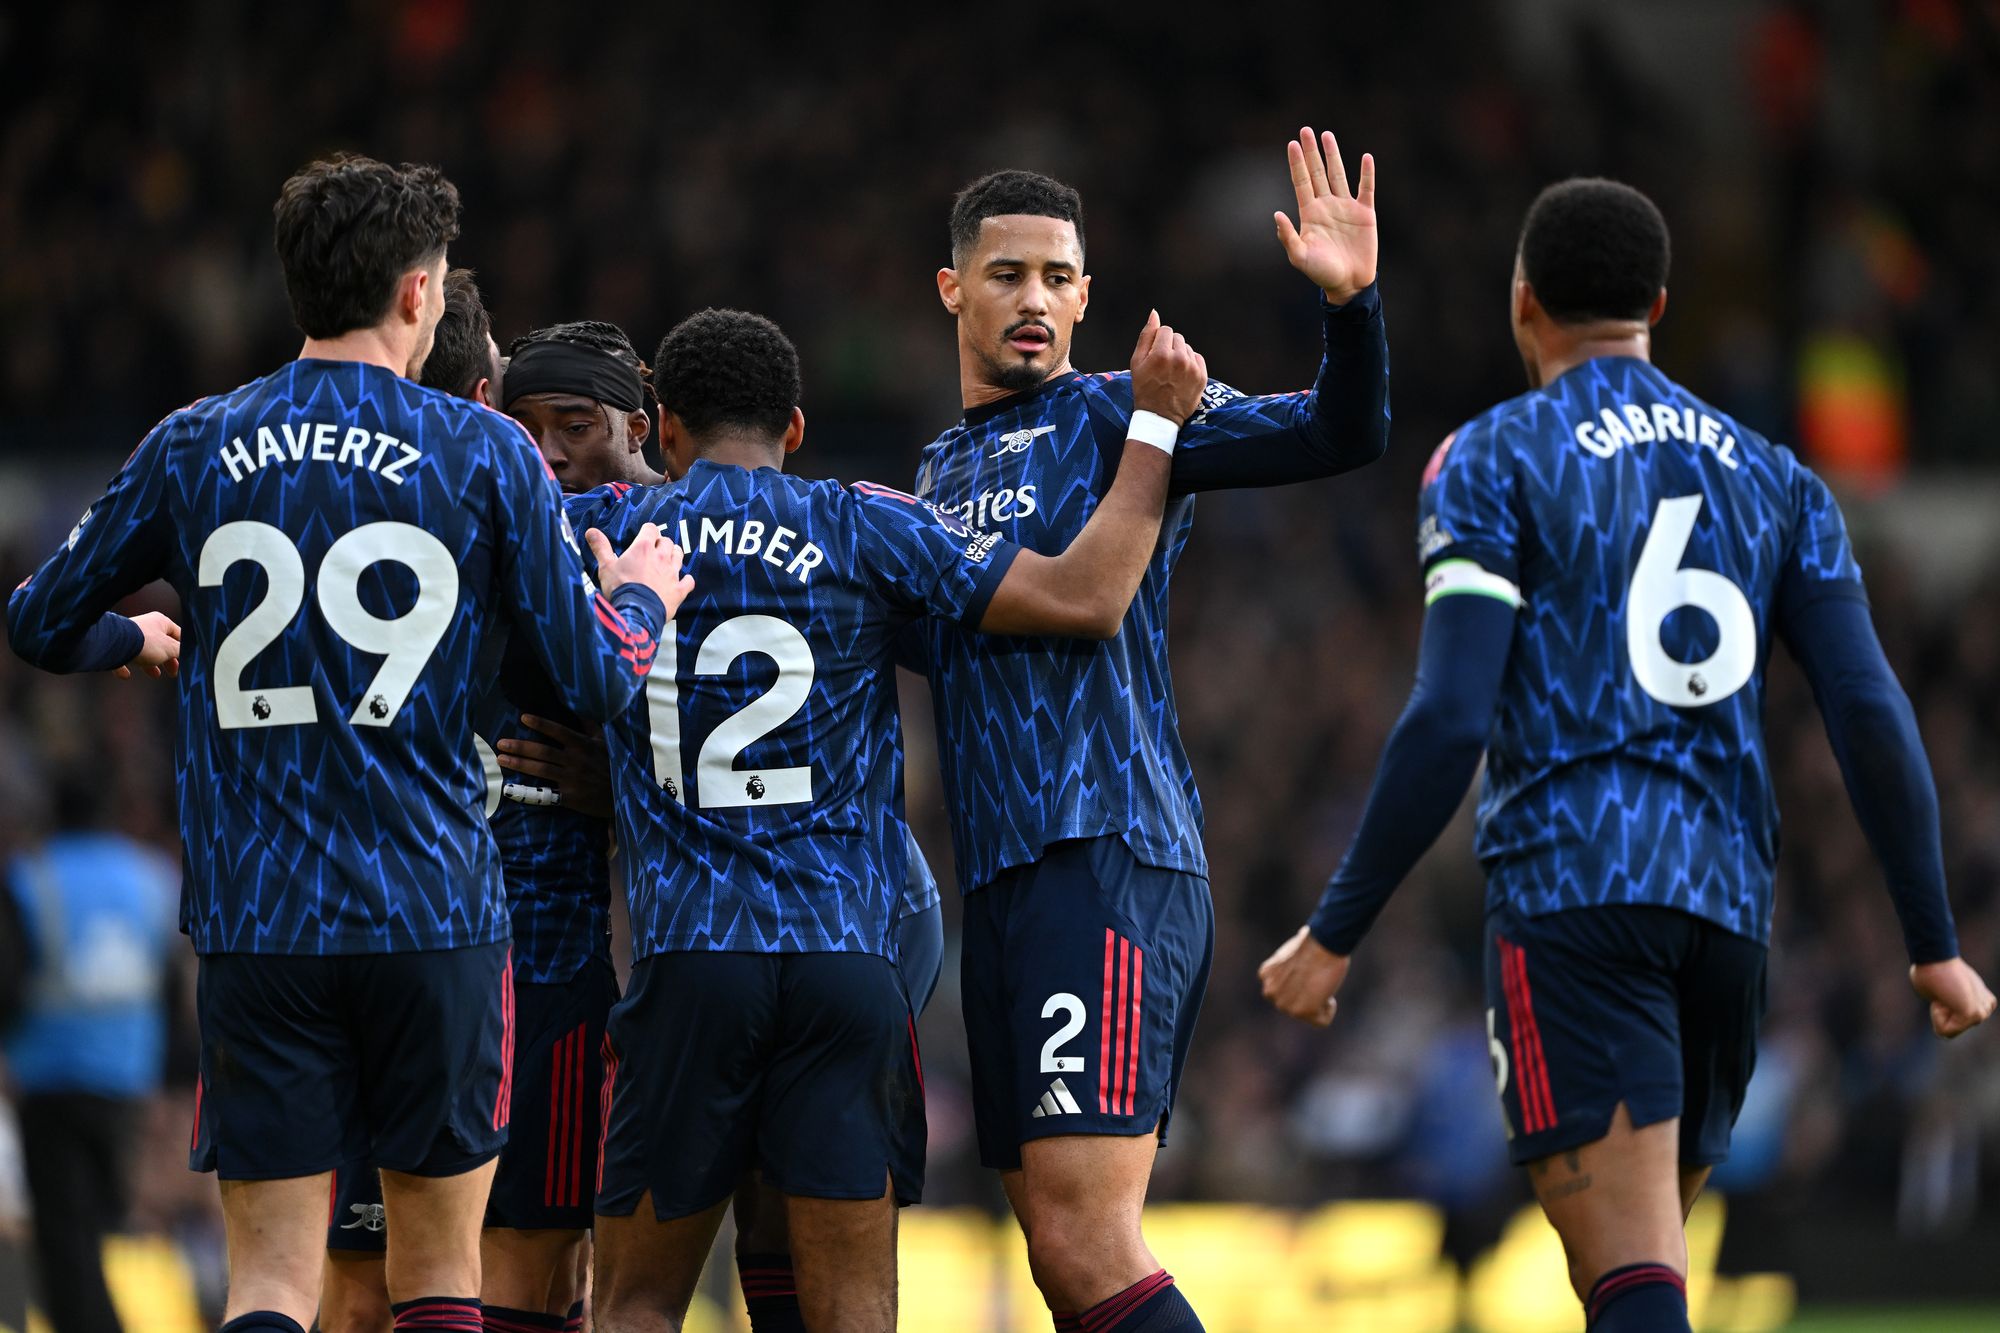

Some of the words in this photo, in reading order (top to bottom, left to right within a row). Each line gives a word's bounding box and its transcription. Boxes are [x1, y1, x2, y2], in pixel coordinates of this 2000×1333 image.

[221, 422, 422, 485] HAVERTZ
[1576, 403, 1740, 470] GABRIEL
[656, 518, 824, 584] IMBER
[199, 521, 459, 729] 29
[1627, 495, 1757, 707] 6
[646, 615, 814, 808] 12
[1041, 993, 1087, 1074] 2
